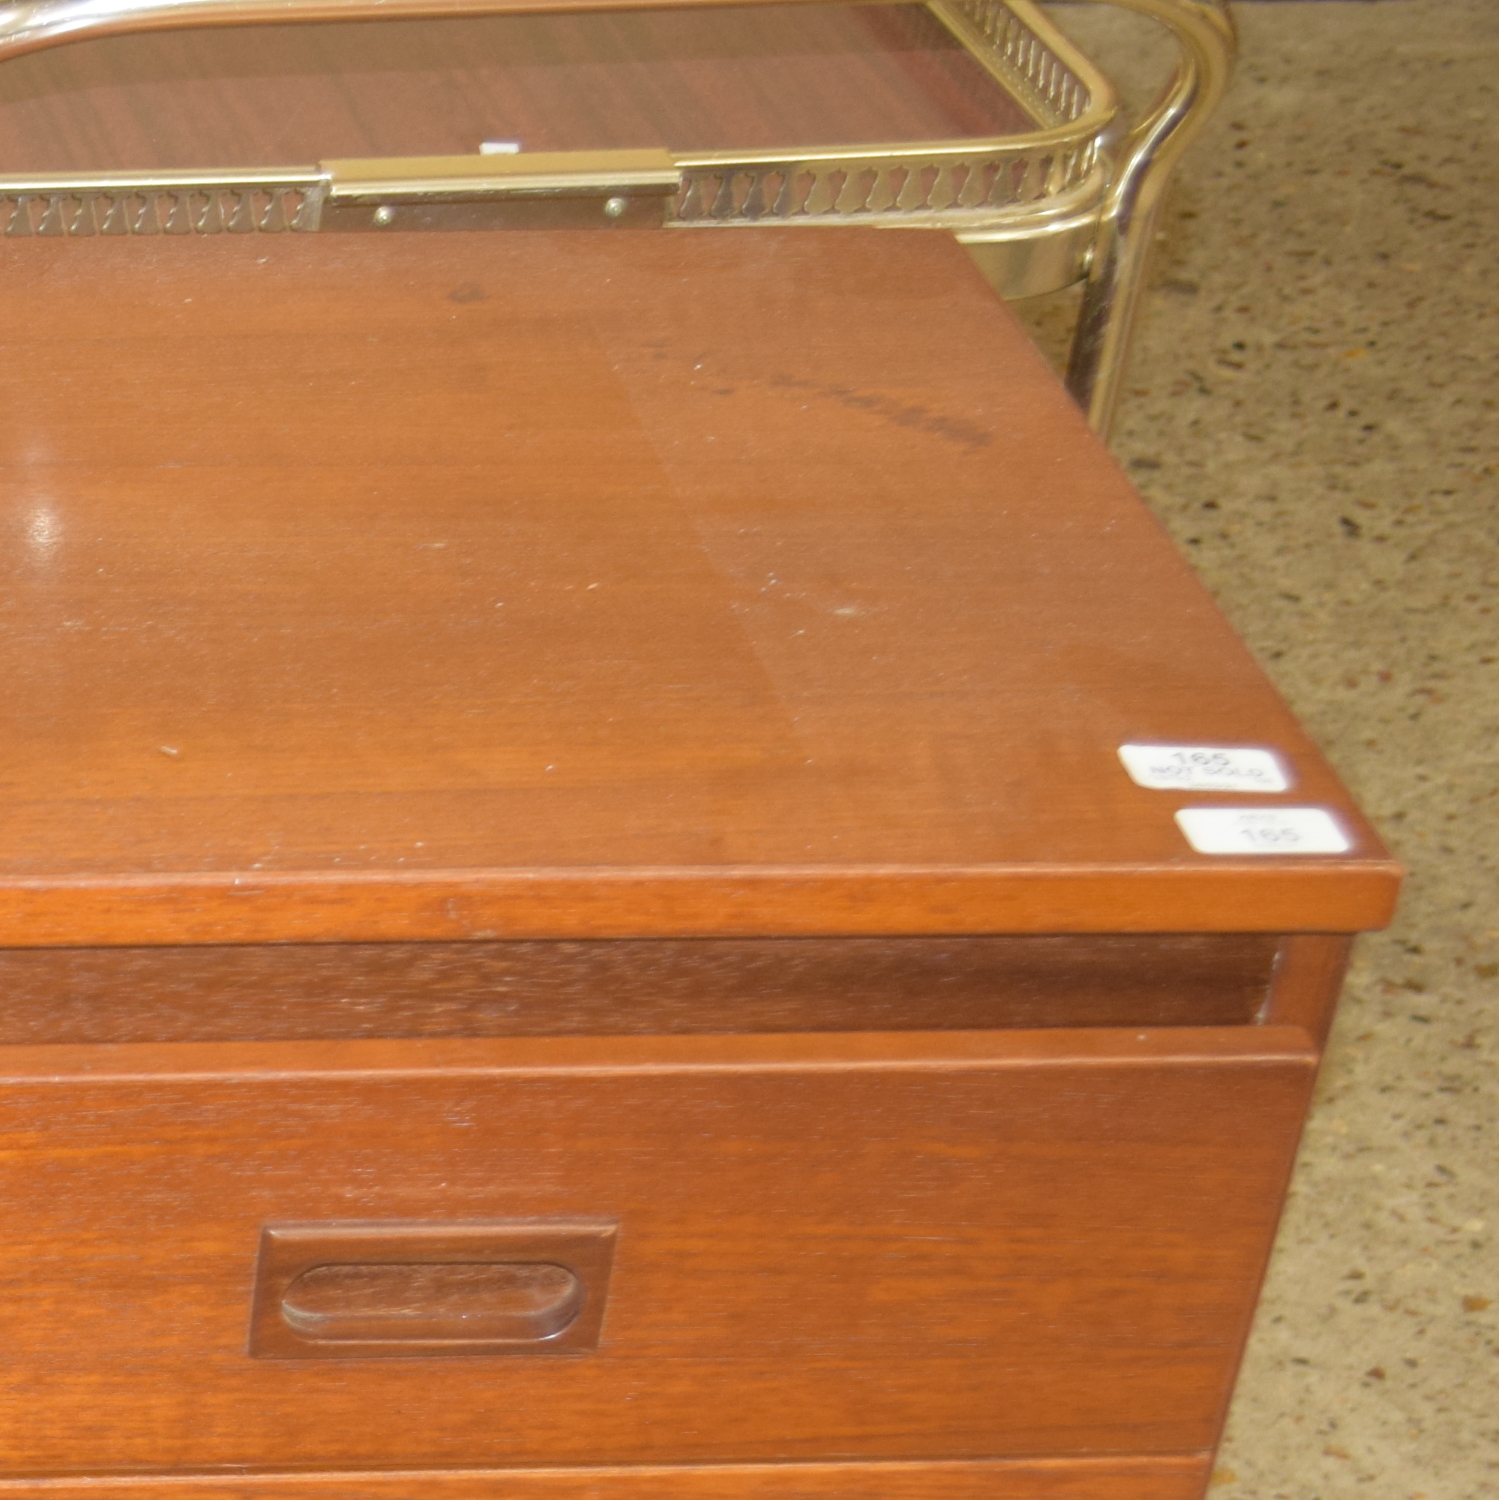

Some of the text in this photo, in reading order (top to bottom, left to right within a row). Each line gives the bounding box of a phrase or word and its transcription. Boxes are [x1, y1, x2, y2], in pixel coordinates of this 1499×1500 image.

[1171, 751, 1231, 766] 165
[1150, 765, 1265, 777] NOT SOLD
[1240, 827, 1301, 842] 165
